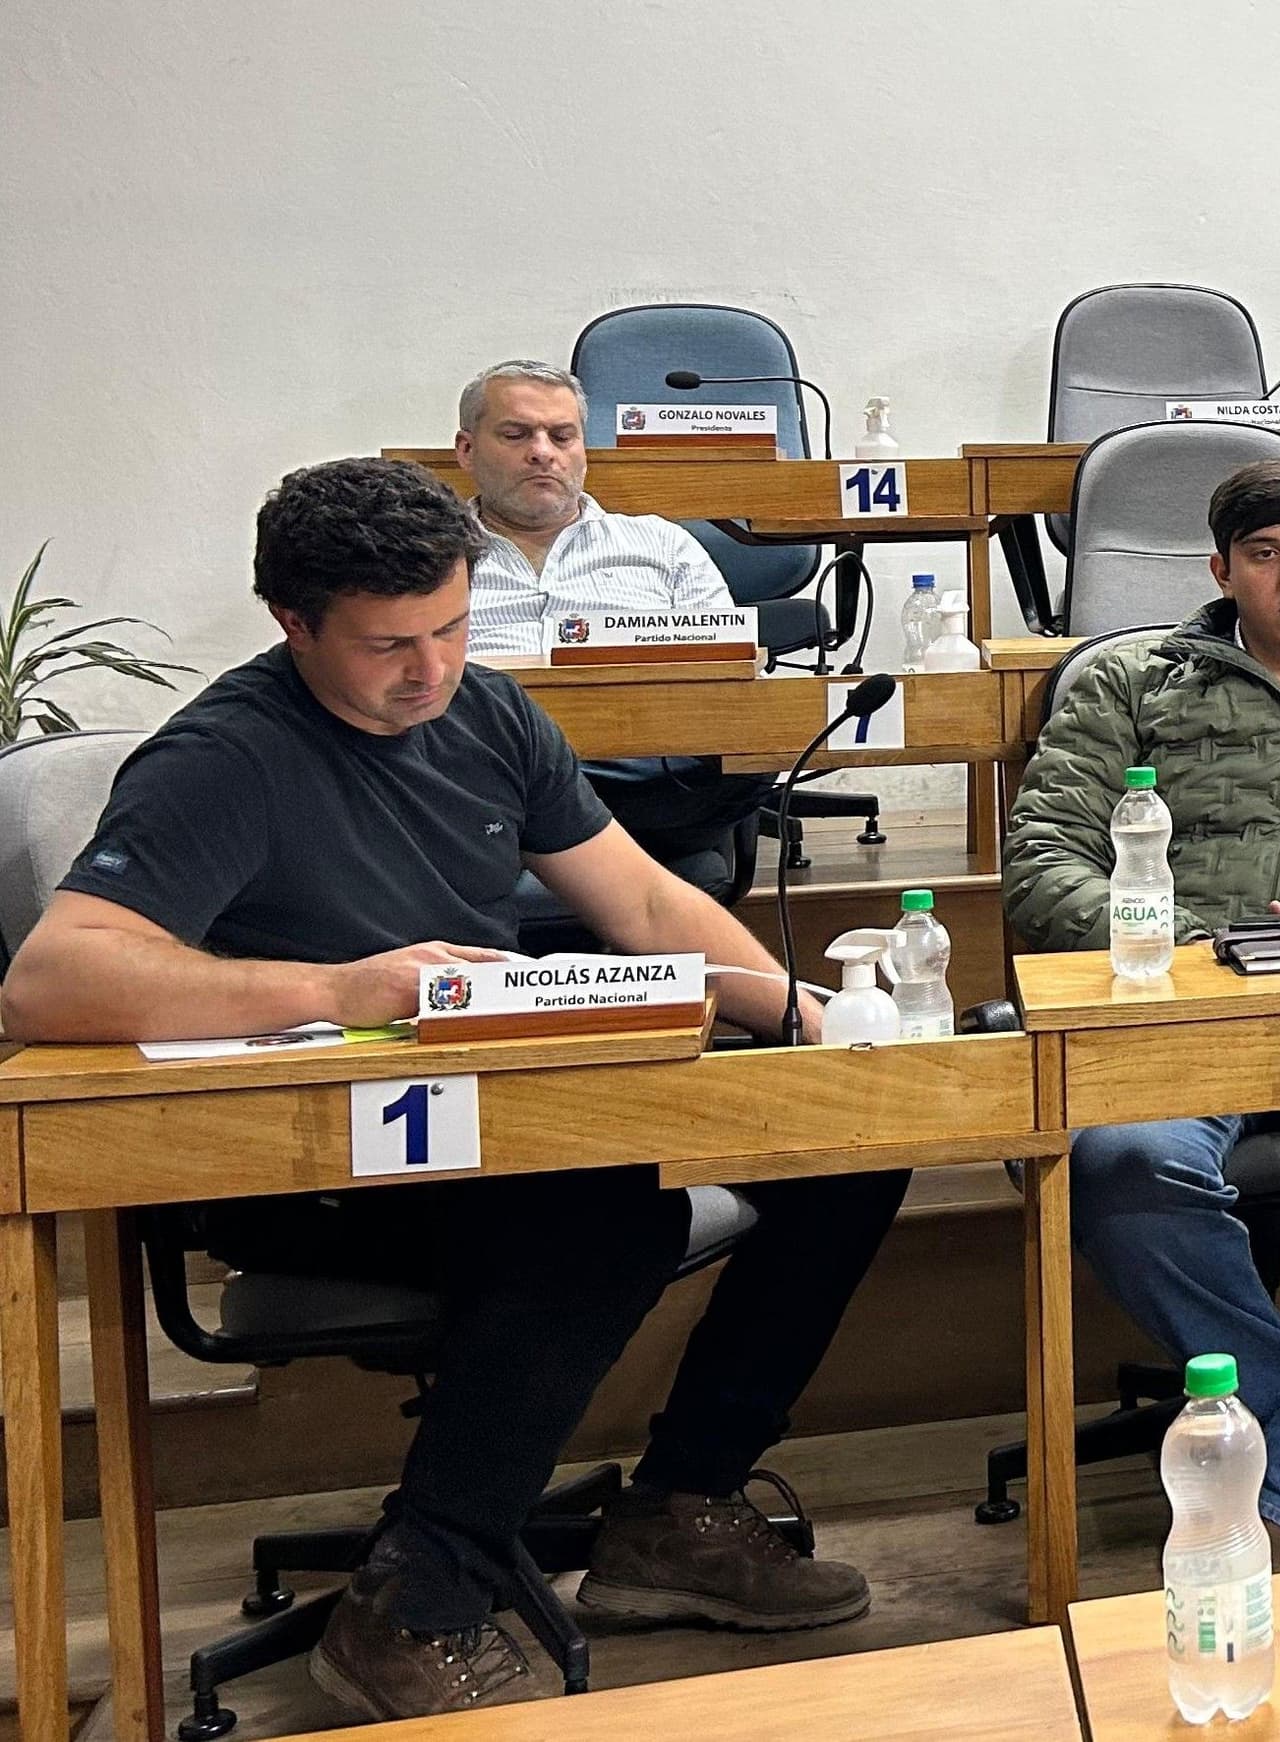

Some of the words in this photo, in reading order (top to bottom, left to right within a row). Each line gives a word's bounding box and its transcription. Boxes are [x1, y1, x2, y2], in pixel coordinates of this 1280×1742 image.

[658, 409, 713, 421] GONZALO
[715, 409, 766, 422] NOVALES
[1217, 405, 1250, 415] NILDA
[691, 425, 733, 433] Presidente
[846, 467, 901, 513] 14
[604, 615, 669, 629] DAMIAN
[671, 613, 745, 628] VALENTIN
[635, 634, 671, 643] Partido
[673, 632, 717, 642] Nacional
[1113, 905, 1158, 921] AGUA
[504, 964, 591, 988] NICOLÁS
[595, 964, 677, 985] AZANZA
[535, 995, 586, 1007] Partido
[588, 991, 648, 1005] Nacional
[382, 1084, 429, 1165] 1
